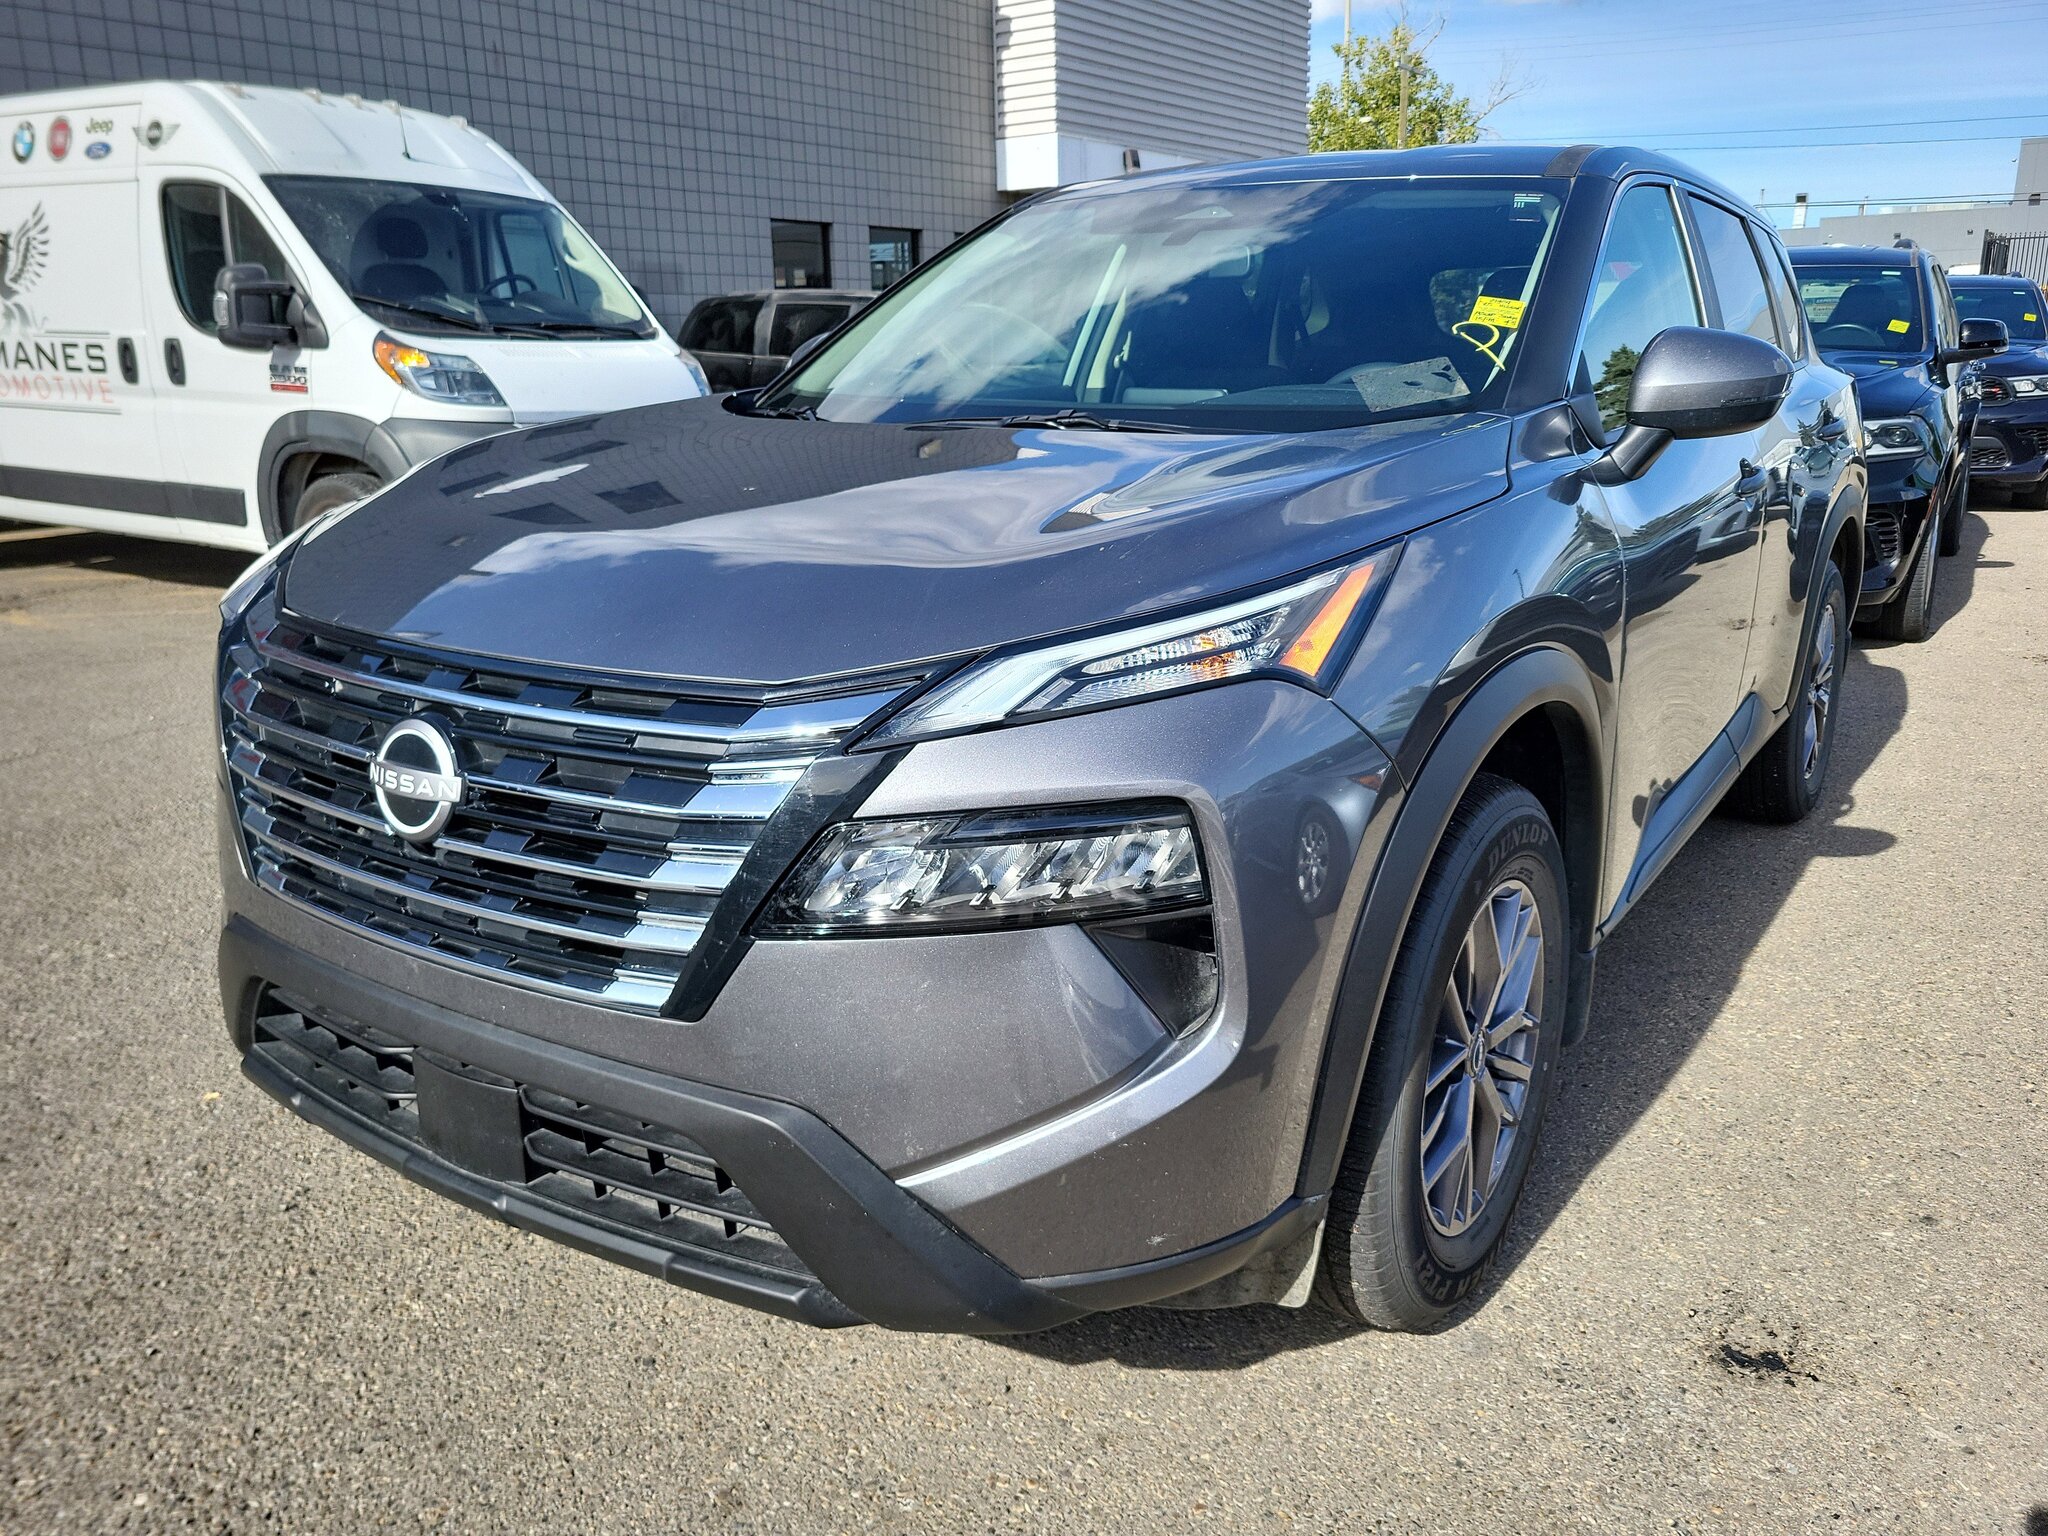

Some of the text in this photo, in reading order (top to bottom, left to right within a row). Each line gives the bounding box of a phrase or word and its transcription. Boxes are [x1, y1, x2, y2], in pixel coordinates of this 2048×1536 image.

[86, 118, 113, 135] Jeep
[370, 762, 458, 799] NISSAN
[1488, 823, 1549, 878] DUNLOP
